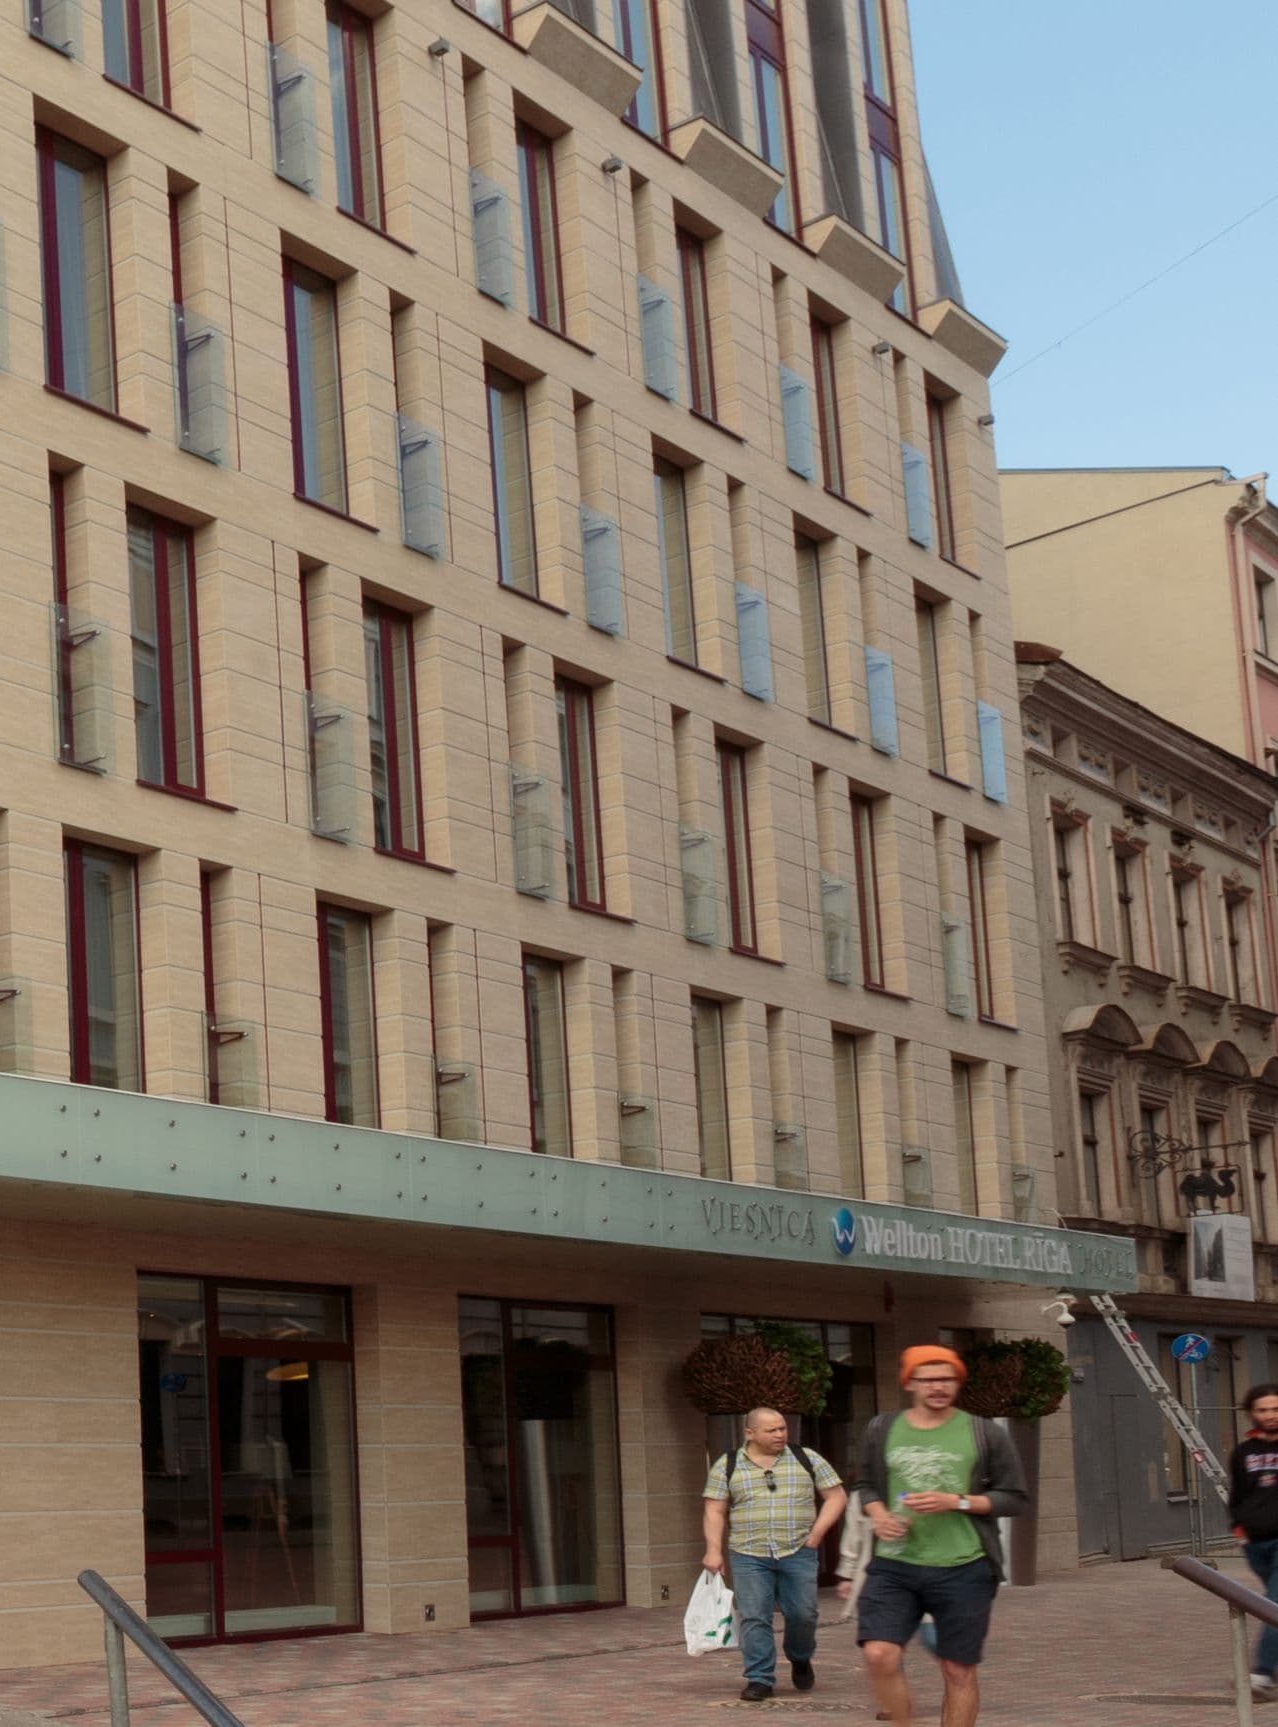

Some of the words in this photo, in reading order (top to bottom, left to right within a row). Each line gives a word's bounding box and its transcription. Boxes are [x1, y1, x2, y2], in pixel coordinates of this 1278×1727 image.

[861, 1216, 943, 1261] Wellton
[946, 1226, 1021, 1269] HOTEL
[1023, 1232, 1073, 1274] RĪGA
